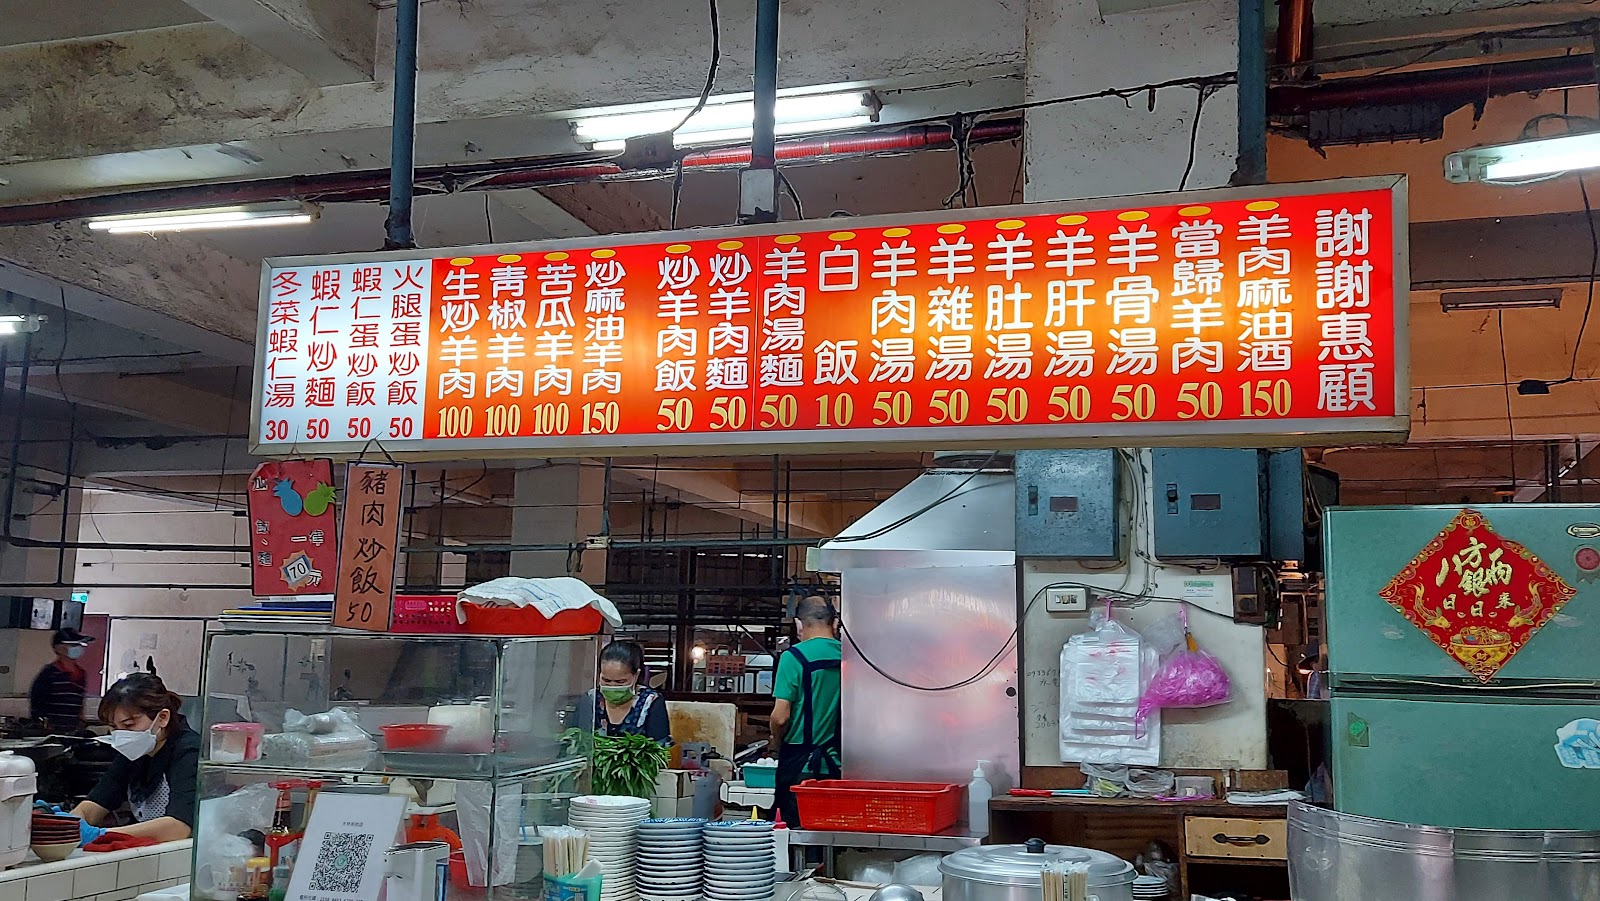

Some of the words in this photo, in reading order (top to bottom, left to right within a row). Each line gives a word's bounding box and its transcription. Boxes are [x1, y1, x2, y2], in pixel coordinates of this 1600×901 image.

[438, 267, 480, 399] 生炒羊肉
[484, 265, 528, 398] 青椒羊肉
[532, 263, 577, 397] 苦瓜羊肉
[581, 259, 627, 396] 炒麻油羊肉
[653, 255, 701, 392] 炒羊肉飯
[705, 252, 752, 392] 炒羊肉麵
[759, 246, 807, 388] 羊肉湯麵
[813, 244, 860, 385] 白飯
[868, 240, 918, 384] 羊肉湯
[925, 236, 976, 381] 羊雜湯
[983, 231, 1036, 380] 羊肚湯
[1044, 227, 1097, 379] 羊肝湯
[1105, 223, 1160, 376] 羊骨湯
[1170, 219, 1224, 375] 當歸羊肉
[1236, 213, 1293, 373] 羊肉麻油酒
[1314, 207, 1376, 412] 謝謝惠顧
[264, 271, 302, 408] 冬菜蝦仁湯
[304, 269, 341, 408] 蝦仁炒麵
[346, 267, 383, 407] 蝦仁蛋炒飯
[387, 265, 424, 406] 火腿蛋炒飯
[265, 419, 288, 440] 30
[306, 418, 330, 439] 50
[347, 417, 371, 438] 50
[389, 416, 413, 438] 50
[437, 406, 473, 437] 100
[484, 404, 522, 436] 100
[533, 403, 570, 435] 100
[581, 401, 620, 434] 150
[656, 397, 694, 432] 50
[709, 396, 747, 431] 50
[760, 394, 798, 429] 50
[815, 392, 854, 427] 10
[872, 390, 912, 426] 50
[928, 388, 969, 425] 50
[986, 386, 1028, 423] 50
[1047, 385, 1091, 422] 50
[1111, 383, 1156, 421] 50
[1176, 381, 1223, 420] 50
[1238, 378, 1292, 417] 150
[289, 562, 307, 579] 70
[350, 470, 388, 595] 豬肉炒飯
[346, 602, 373, 623] 50
